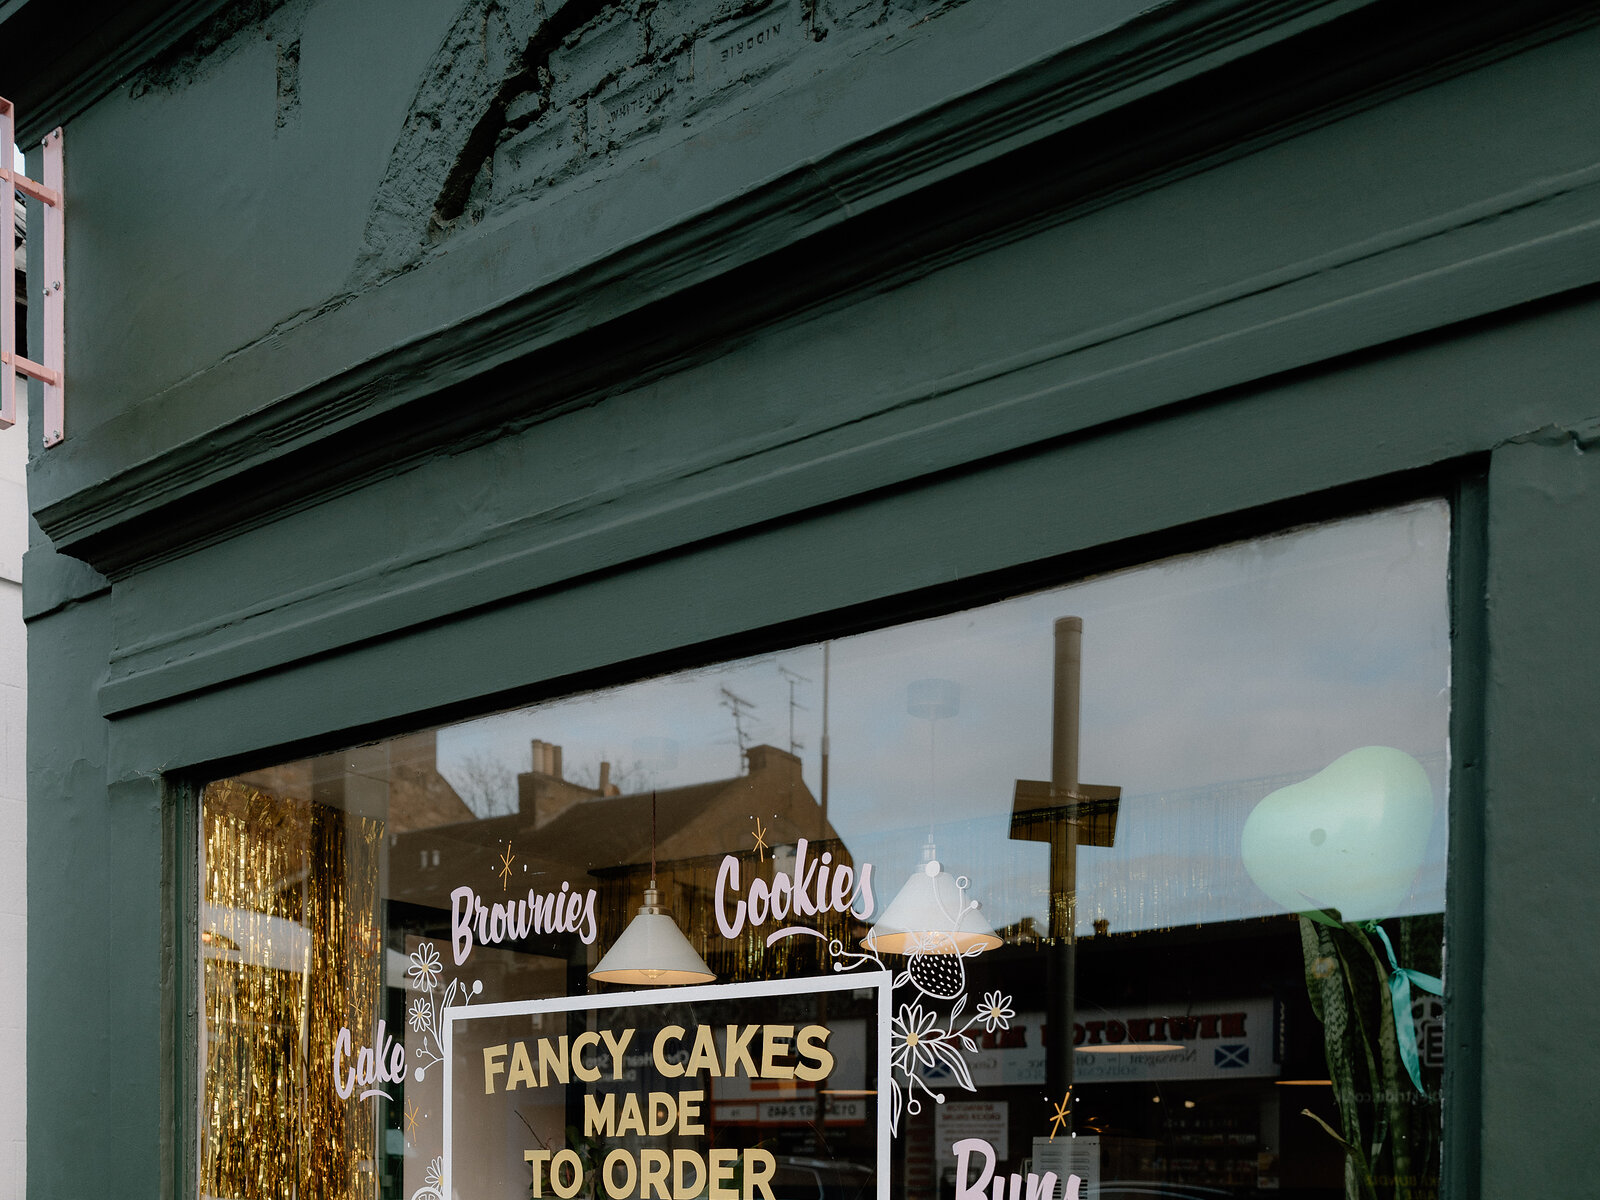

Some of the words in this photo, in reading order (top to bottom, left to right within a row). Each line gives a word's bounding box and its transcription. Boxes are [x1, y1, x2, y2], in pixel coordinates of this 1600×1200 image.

[450, 881, 597, 967] Brownies
[715, 838, 875, 940] Cookies
[333, 1019, 407, 1100] Cake
[483, 1029, 636, 1095] FANCY
[652, 1025, 835, 1080] CAKES
[584, 1091, 705, 1138] MADE
[524, 1149, 584, 1200] TO
